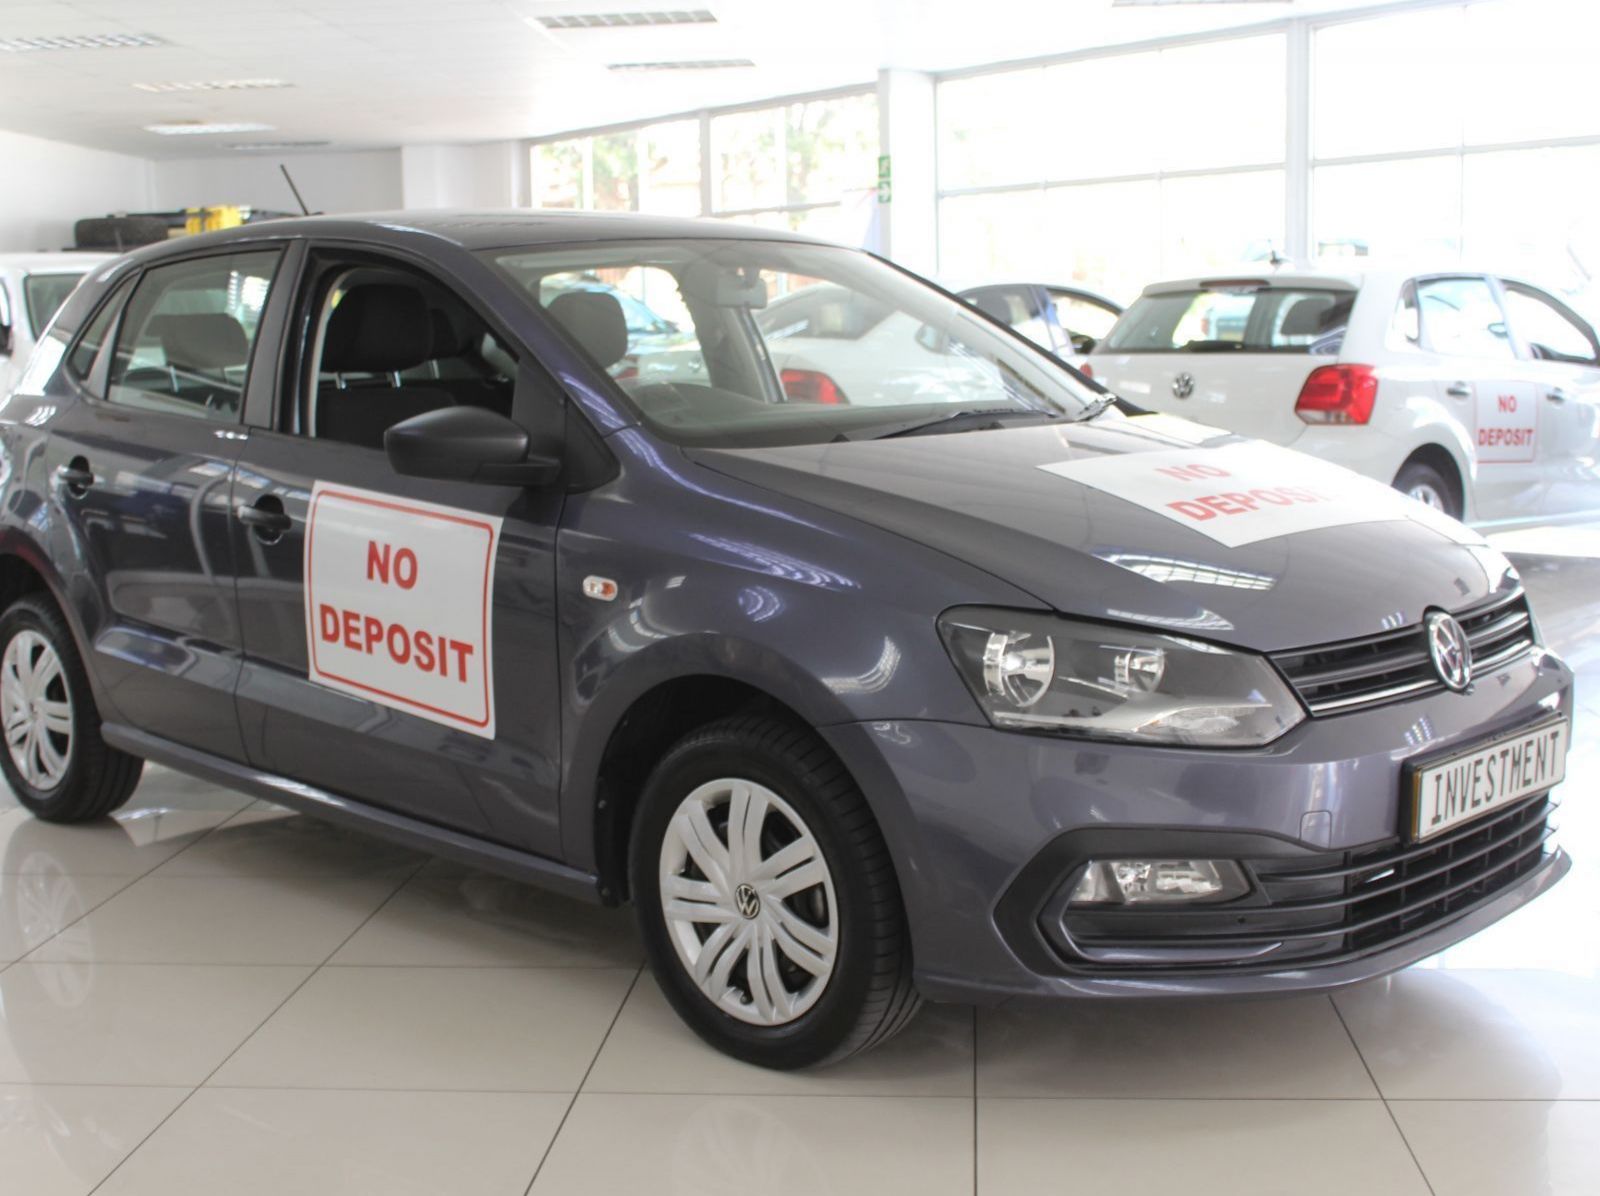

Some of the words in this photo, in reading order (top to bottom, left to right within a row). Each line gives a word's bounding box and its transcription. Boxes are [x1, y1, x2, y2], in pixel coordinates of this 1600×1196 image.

[1497, 394, 1518, 413] NO
[1478, 427, 1534, 447] DEPOSIT
[1152, 463, 1232, 482] NO
[366, 540, 418, 590] NO
[319, 603, 474, 683] DEPOSIT
[1431, 730, 1560, 826] INVESTMENT
